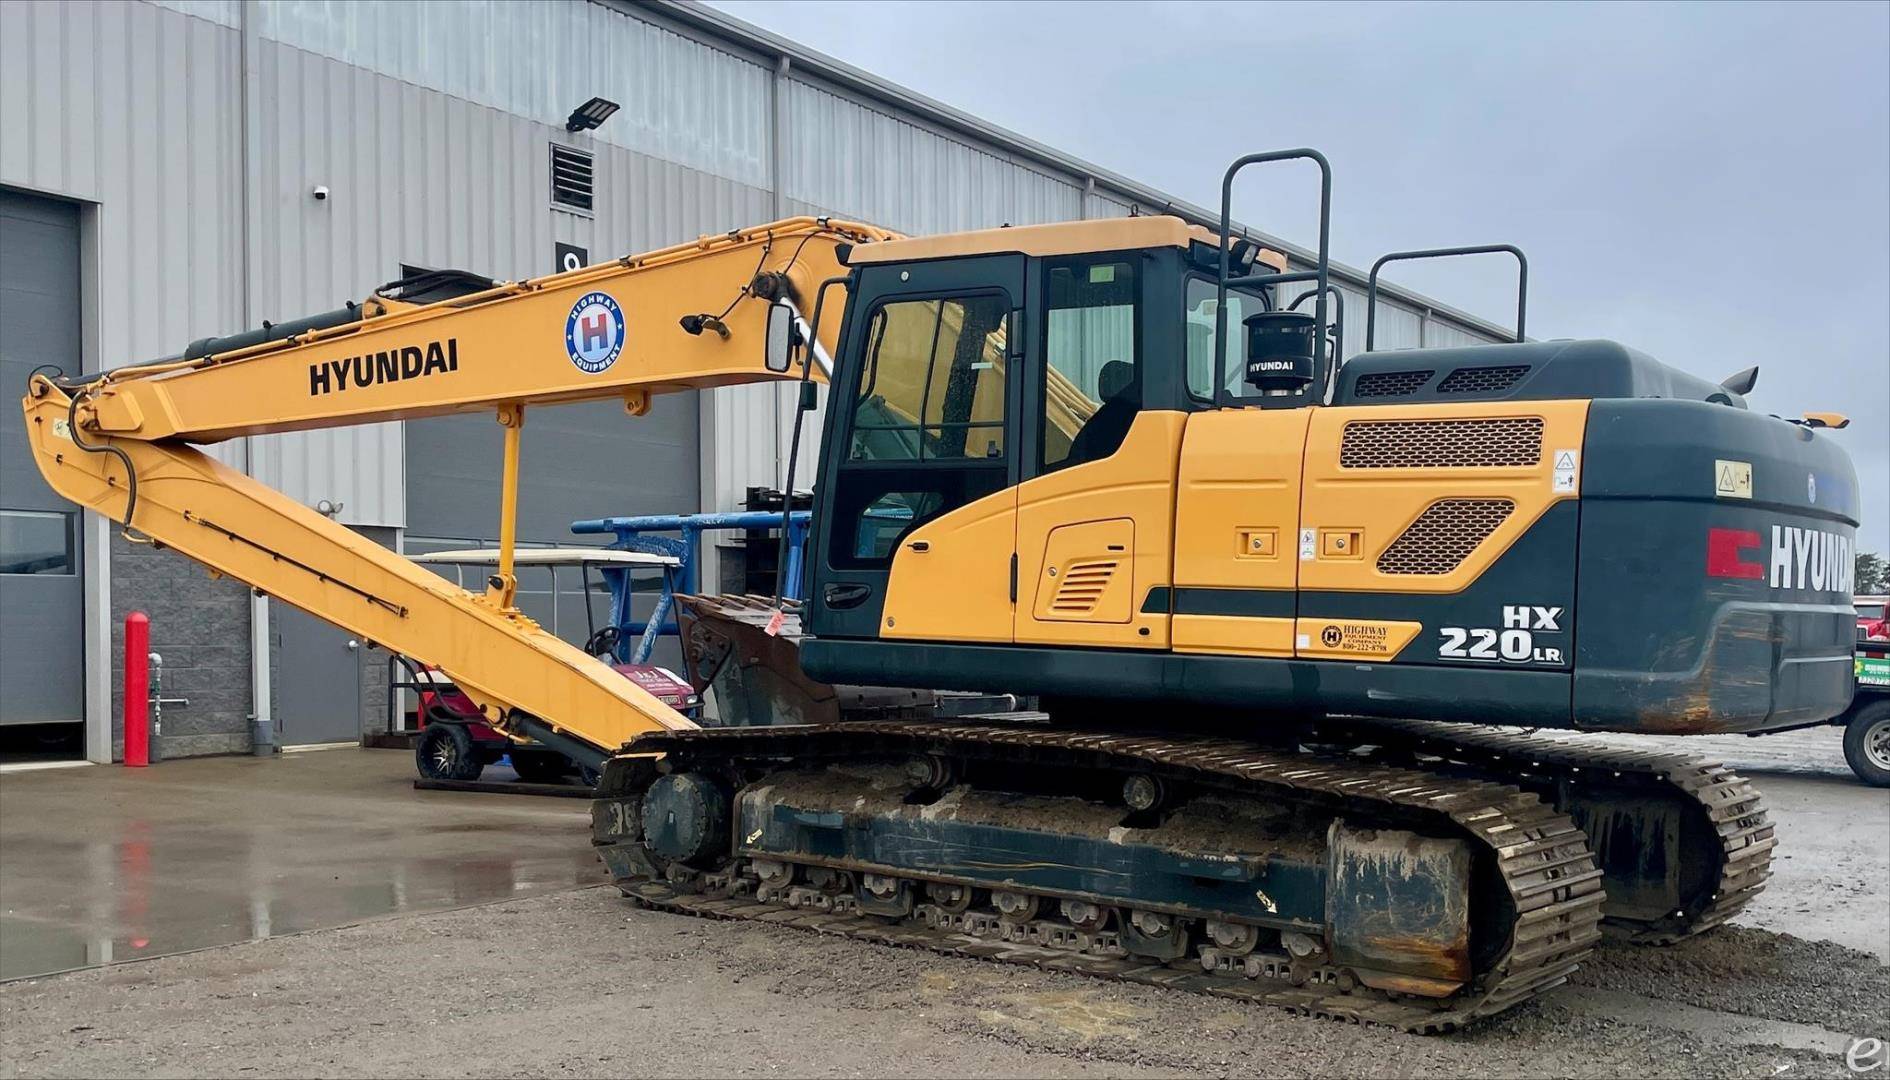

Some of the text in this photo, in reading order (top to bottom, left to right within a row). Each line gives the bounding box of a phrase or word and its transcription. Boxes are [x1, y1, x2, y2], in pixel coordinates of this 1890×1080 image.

[571, 294, 618, 320] HIGHWAY
[582, 313, 608, 352] H
[310, 338, 458, 396] HYUNDAI
[572, 343, 621, 371] EQUIPMENT
[1250, 361, 1293, 372] HYUNDAI
[1503, 605, 1561, 630] HX
[1327, 631, 1337, 642] H
[1344, 625, 1388, 636] HIGHWAY
